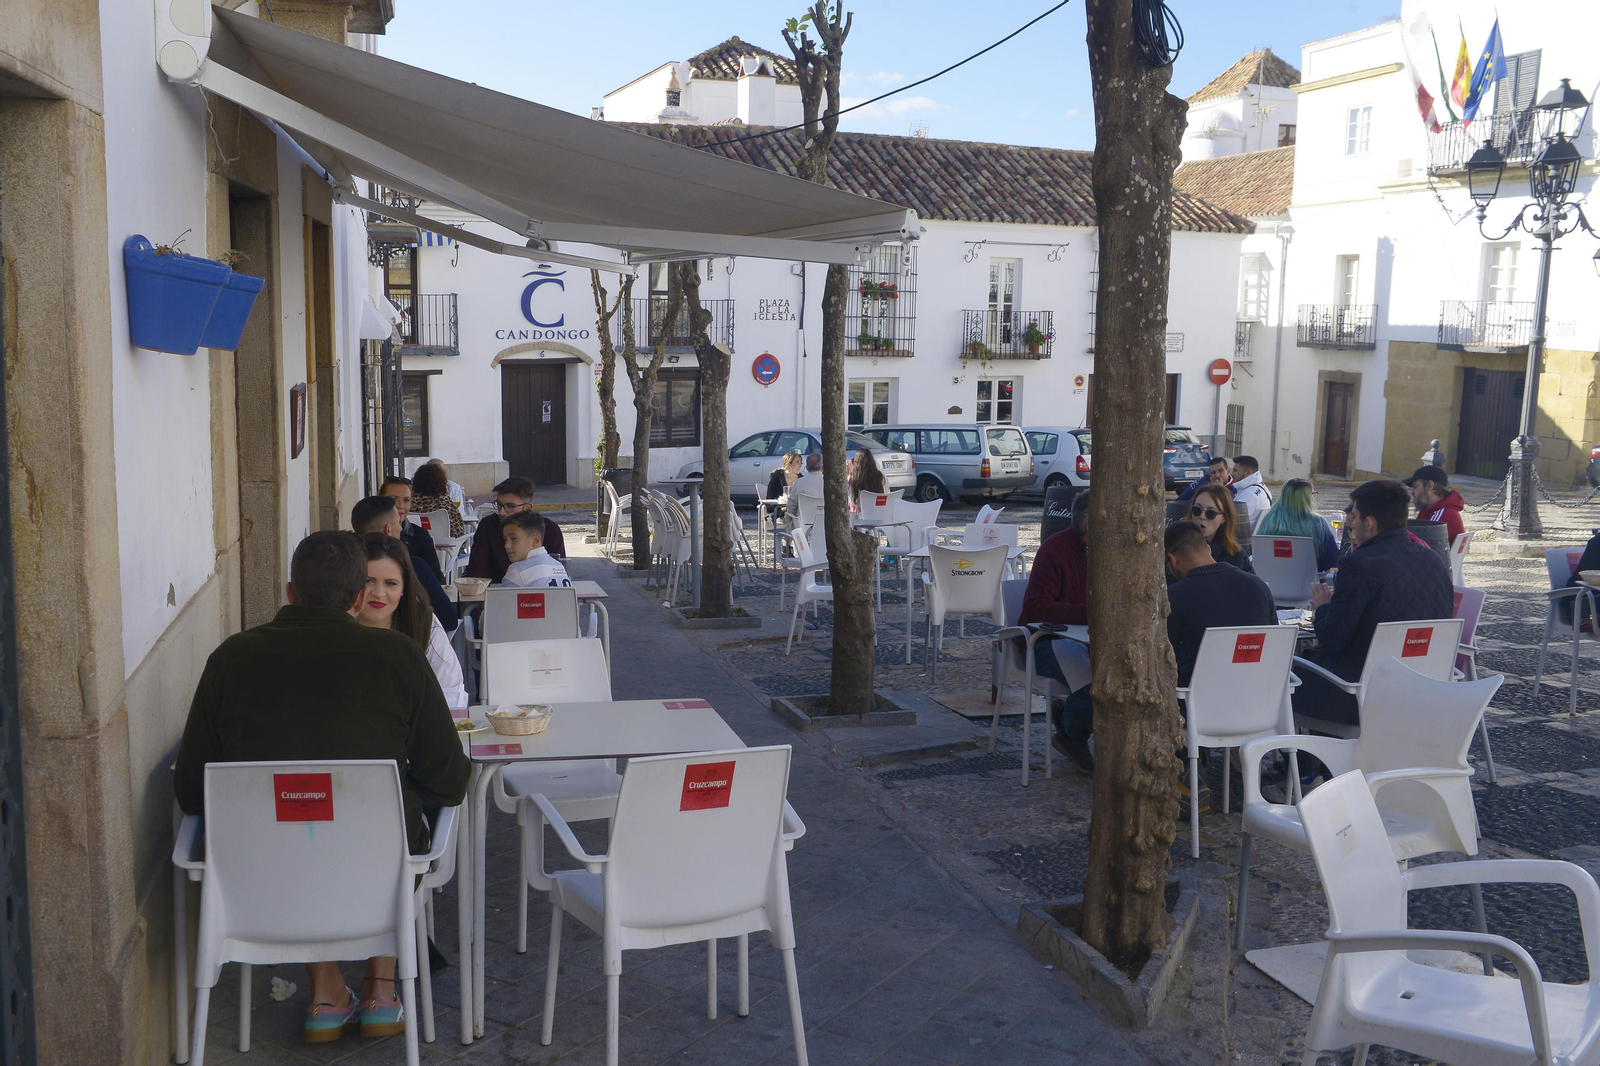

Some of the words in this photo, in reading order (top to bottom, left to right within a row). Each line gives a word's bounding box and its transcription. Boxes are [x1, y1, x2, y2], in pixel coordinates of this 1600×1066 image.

[759, 299, 790, 307] PLAZA
[759, 306, 771, 314] DE
[777, 306, 790, 314] LA
[753, 313, 796, 321] IGLESIA
[495, 329, 590, 340] CANDONGO
[689, 779, 728, 789] Cruzcampo
[281, 791, 326, 800] Cruzcampo
